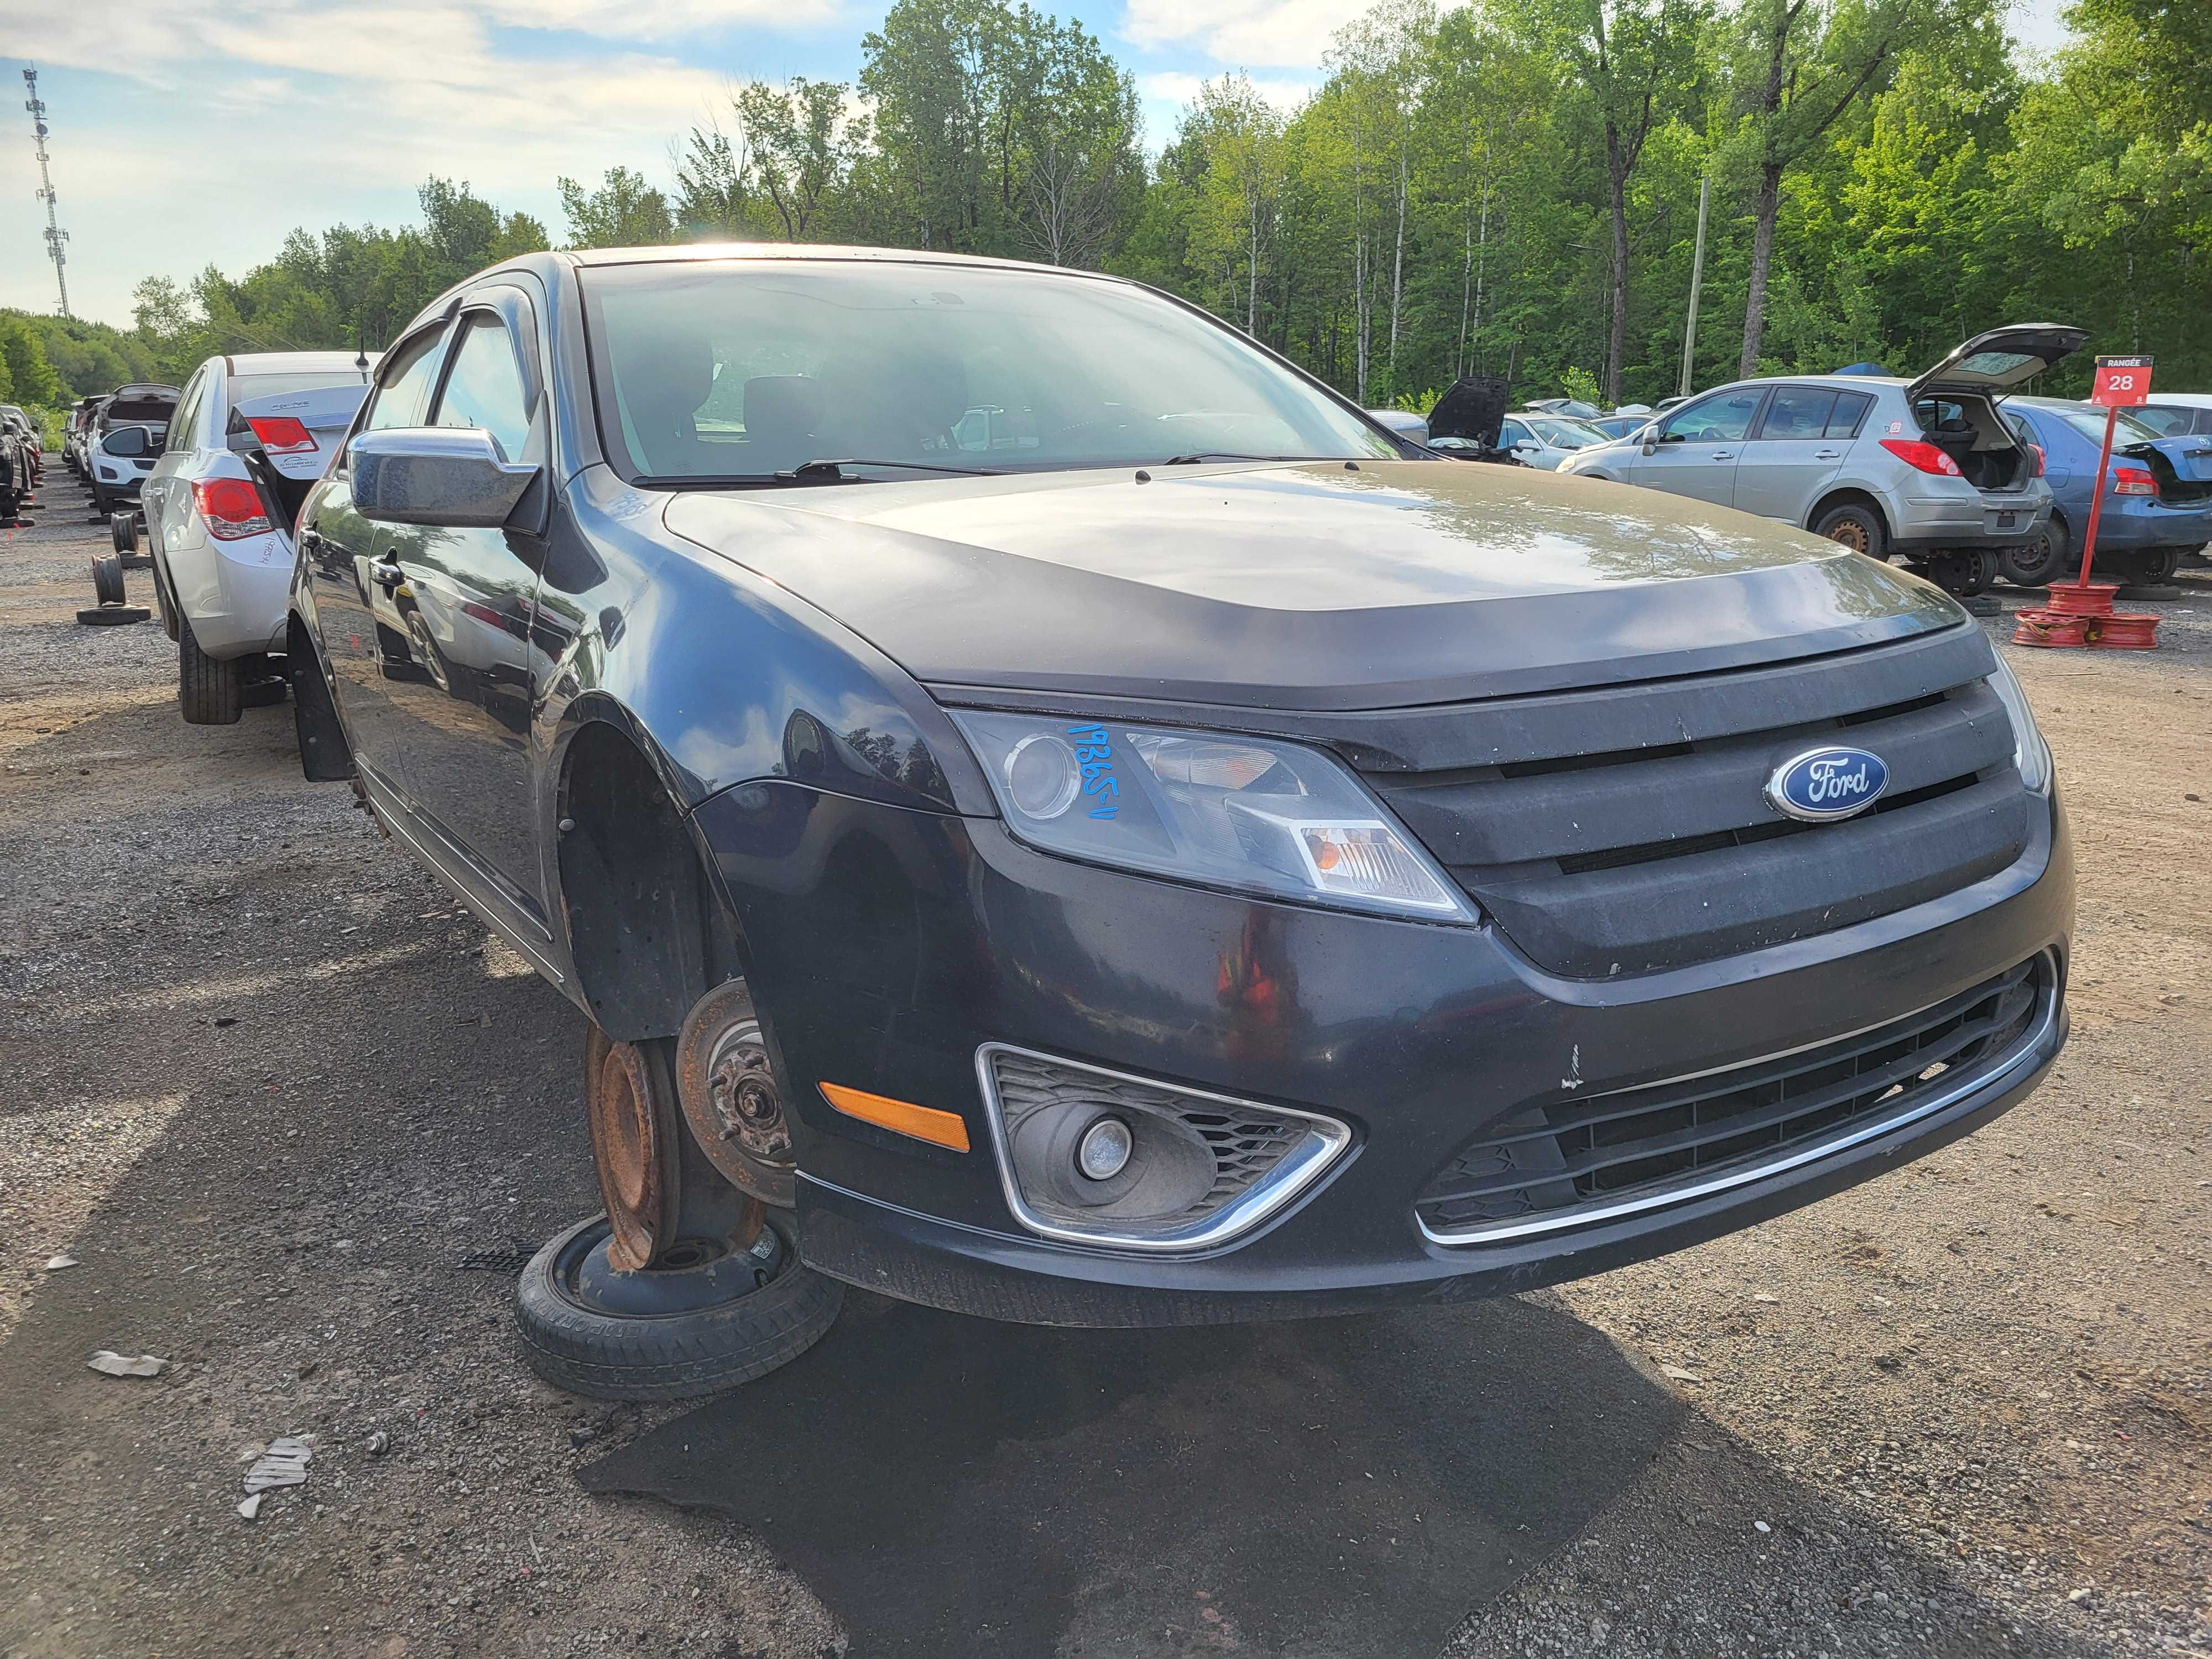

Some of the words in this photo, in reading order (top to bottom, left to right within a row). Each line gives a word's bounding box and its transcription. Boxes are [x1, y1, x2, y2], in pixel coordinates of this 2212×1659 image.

[2107, 358, 2141, 367] RANGÉE
[2109, 375, 2133, 390] 28
[270, 400, 310, 411] CRUZE
[1067, 723, 1119, 820] 19365-11
[1808, 758, 1870, 802] Ford
